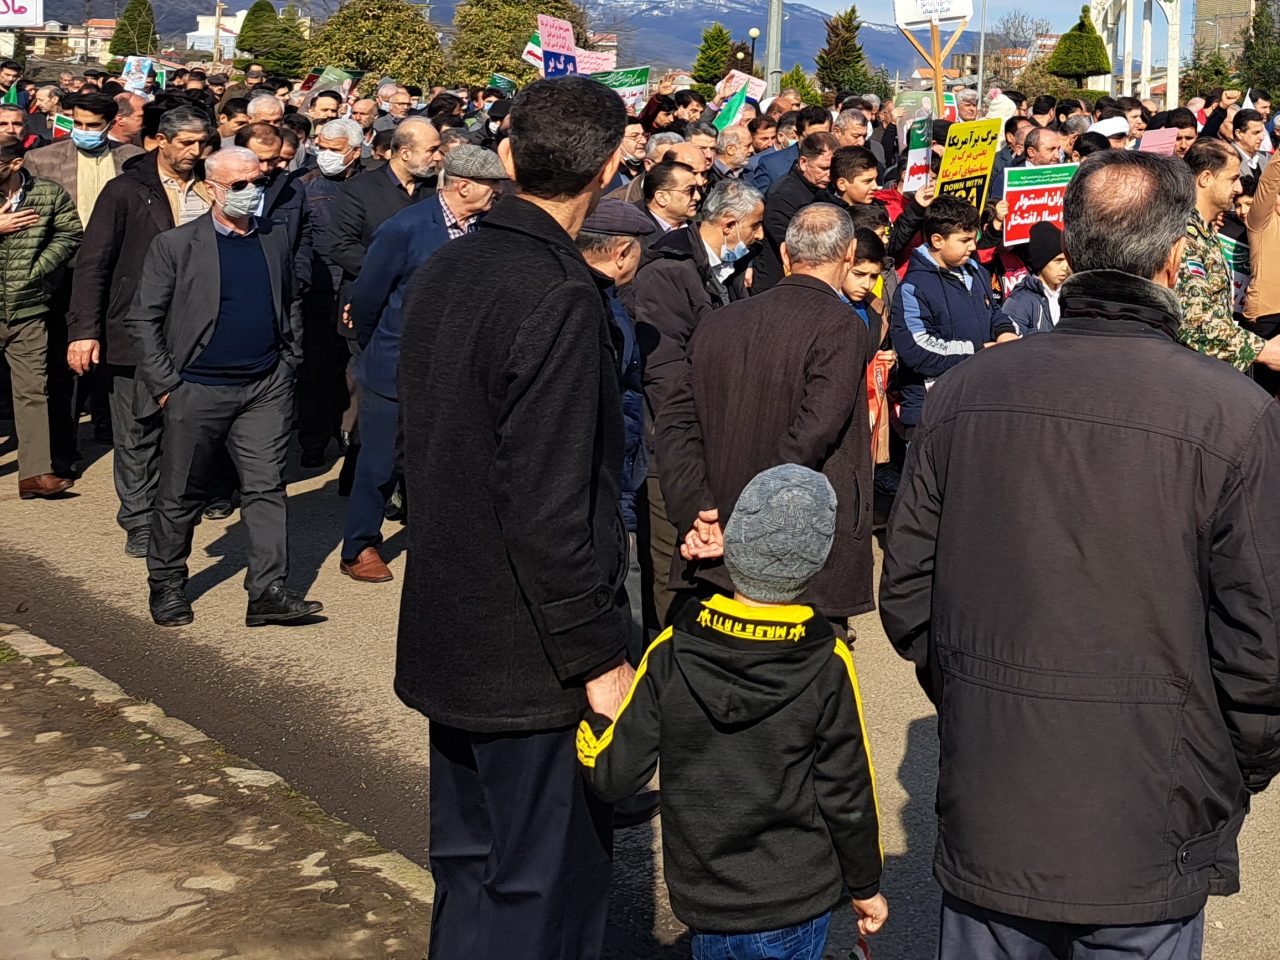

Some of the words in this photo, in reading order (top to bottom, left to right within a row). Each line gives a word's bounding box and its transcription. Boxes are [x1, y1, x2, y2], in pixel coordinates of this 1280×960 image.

[948, 131, 975, 150] آمریکا
[971, 135, 980, 148] بر
[980, 130, 998, 145] مرگ
[943, 182, 965, 192] DOWN
[966, 178, 983, 188] WITH
[1014, 191, 1049, 211] استوار
[1007, 211, 1037, 231] افتخار
